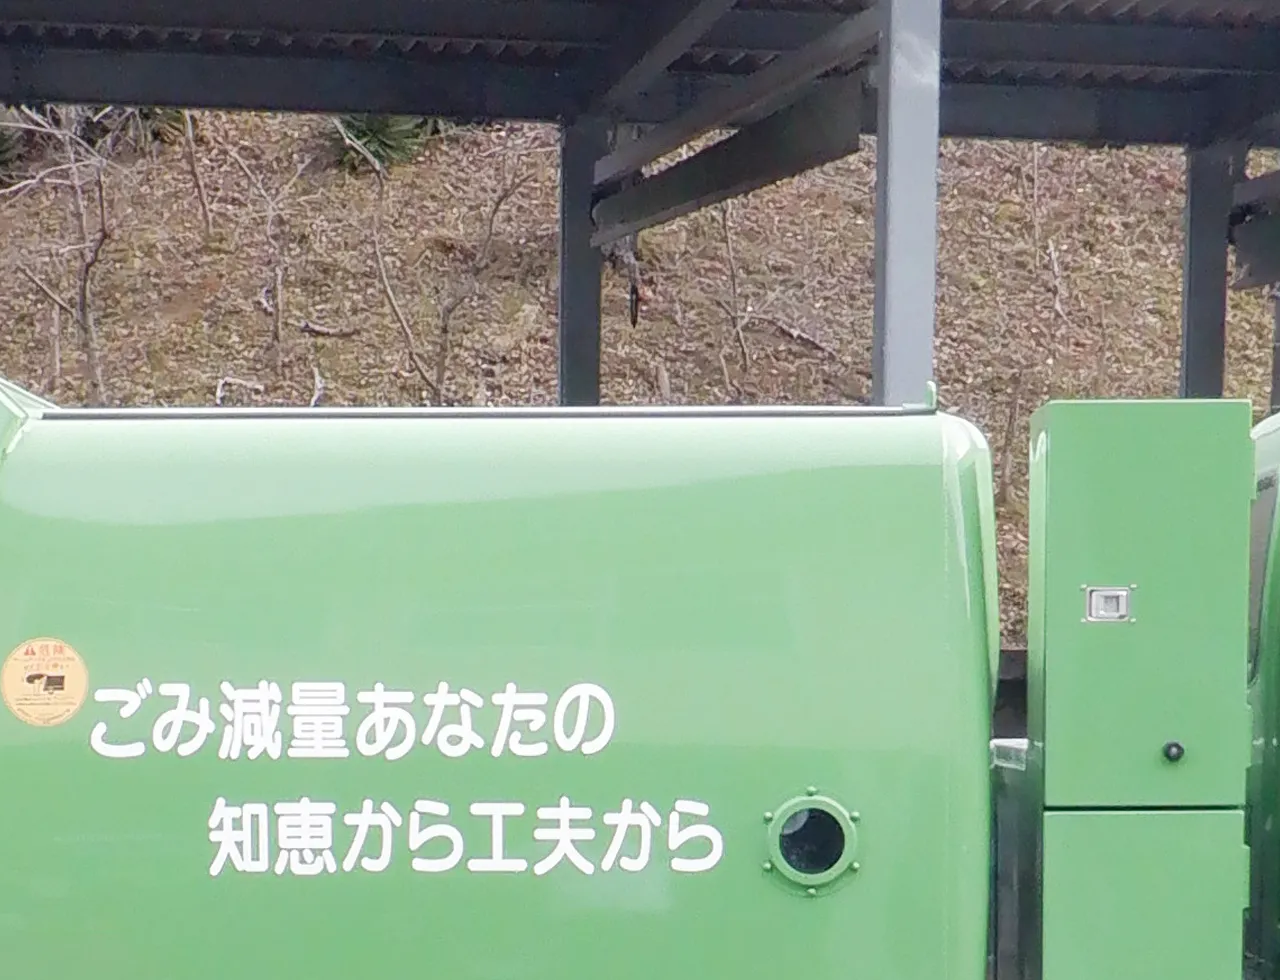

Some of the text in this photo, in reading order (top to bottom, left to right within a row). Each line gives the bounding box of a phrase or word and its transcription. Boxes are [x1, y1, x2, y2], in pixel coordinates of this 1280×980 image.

[89, 677, 616, 761] ごみ減量あなたの
[207, 796, 724, 877] 知恵から工夫から
